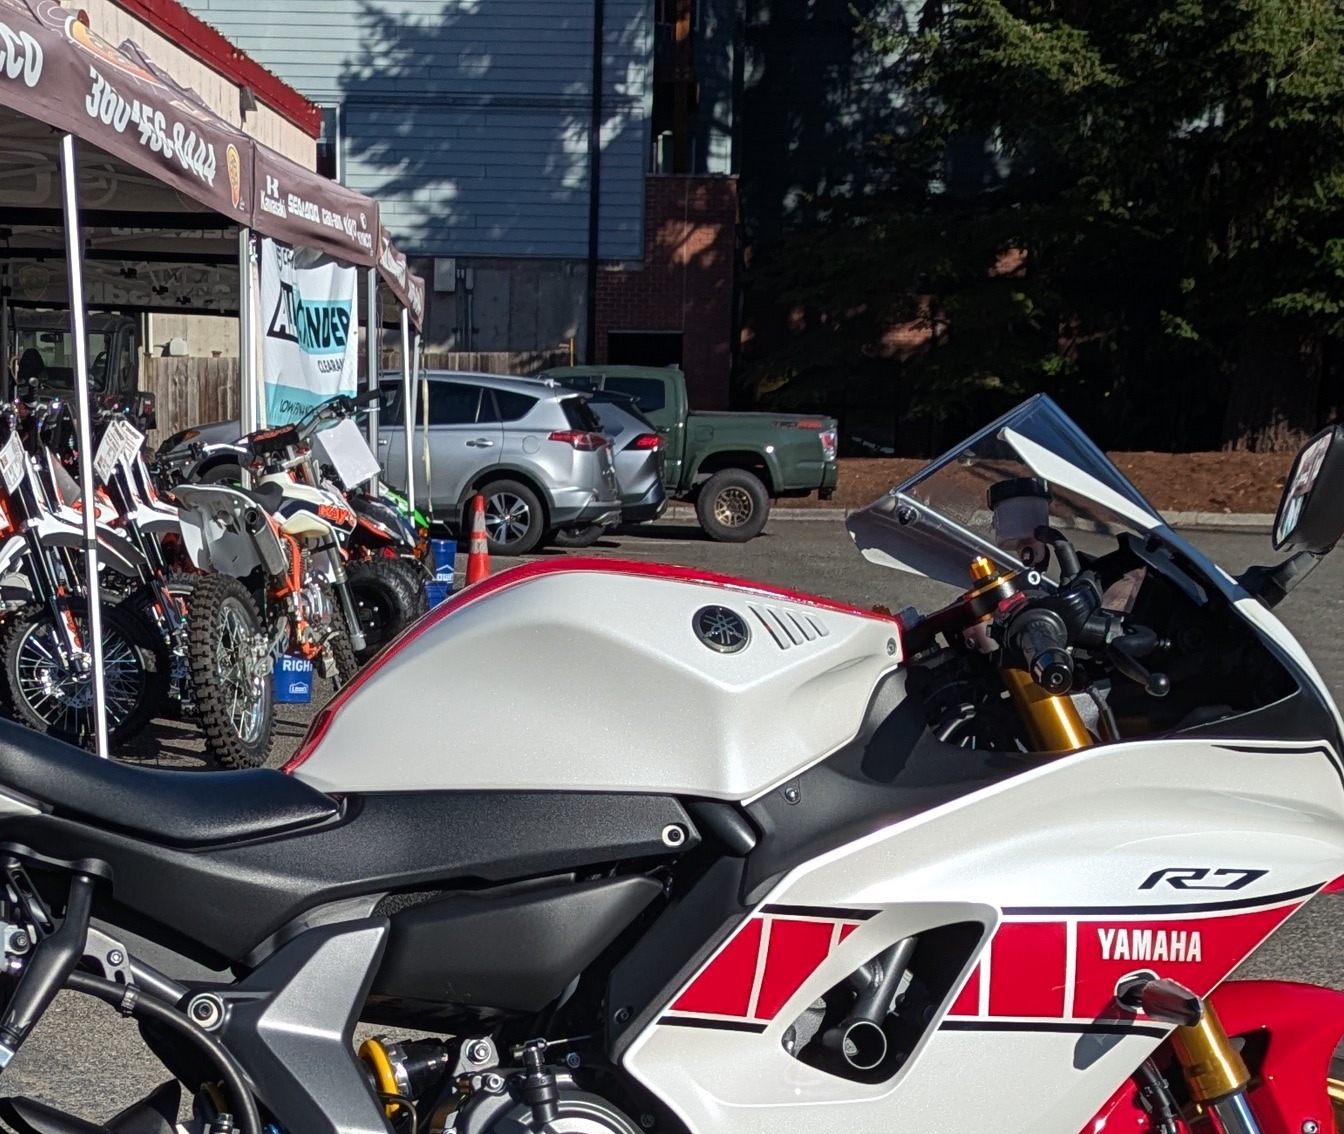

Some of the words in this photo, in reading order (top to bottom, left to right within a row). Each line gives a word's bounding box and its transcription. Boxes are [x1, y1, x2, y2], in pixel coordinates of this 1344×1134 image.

[85, 65, 216, 187] 360-456-8444
[1137, 867, 1270, 890] R7
[1097, 927, 1202, 962] YAMAHA
